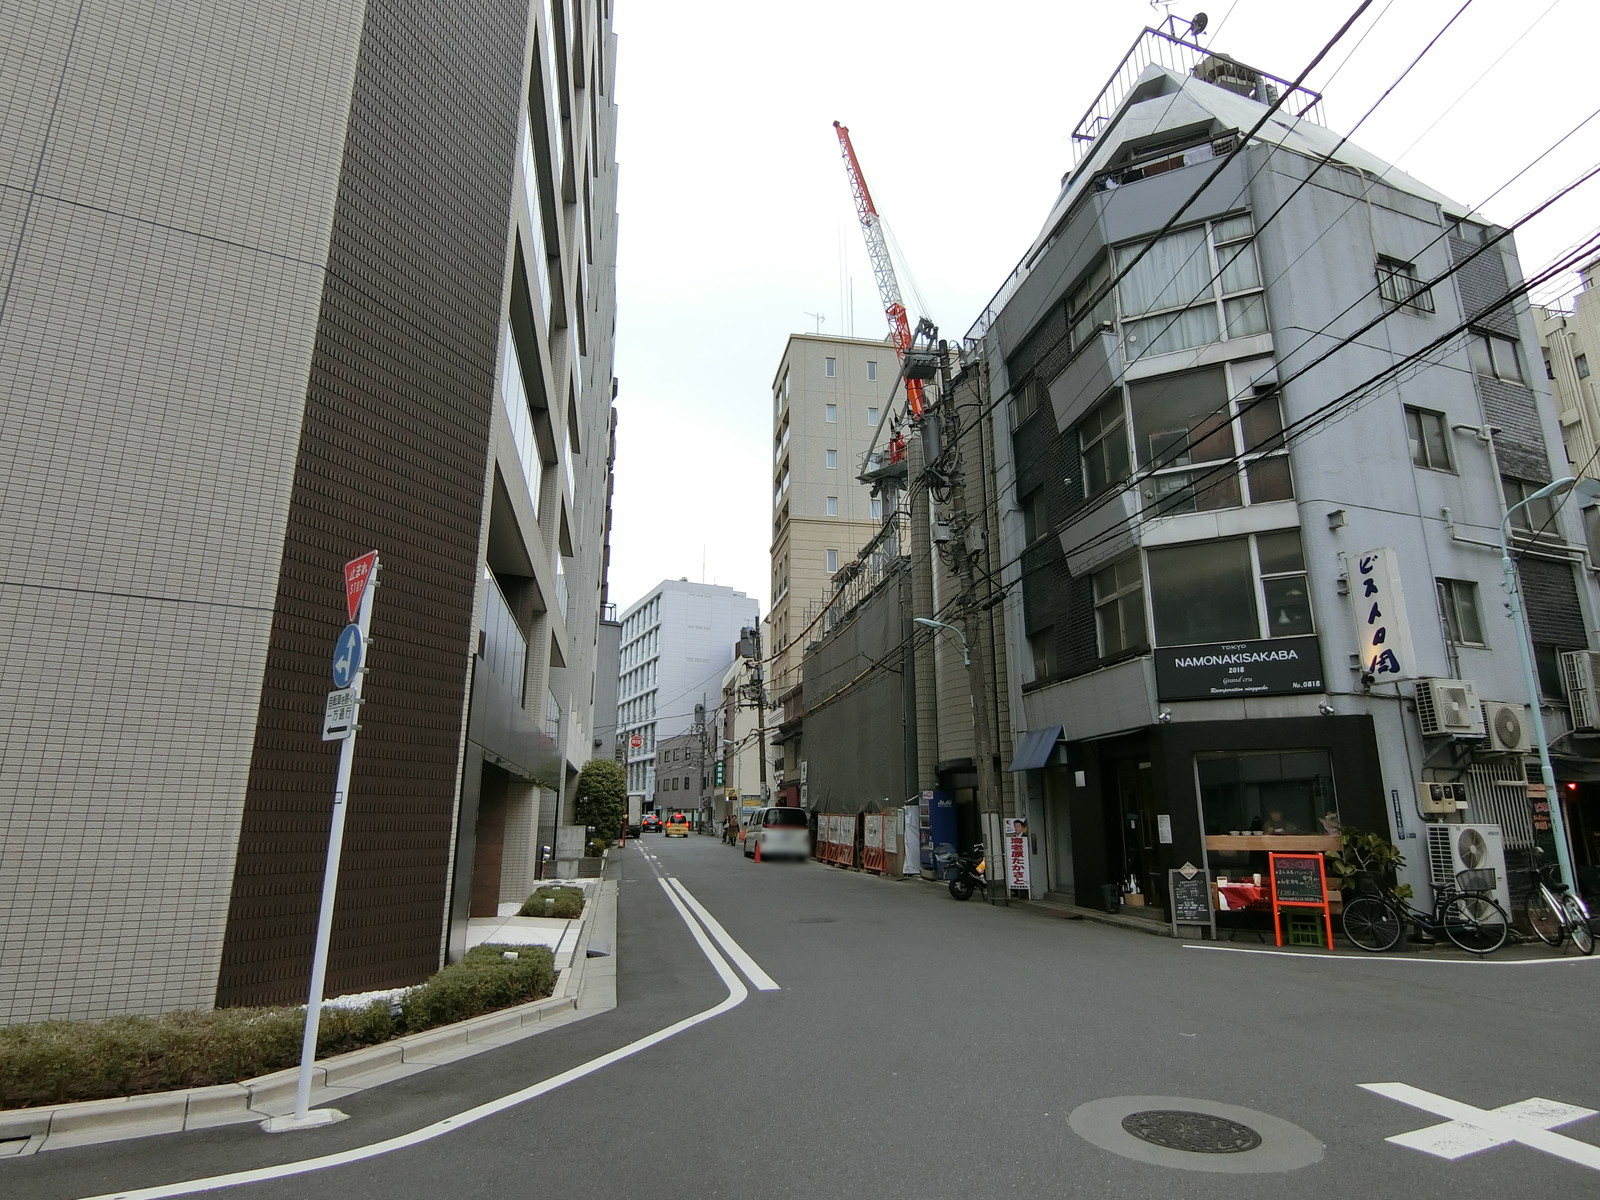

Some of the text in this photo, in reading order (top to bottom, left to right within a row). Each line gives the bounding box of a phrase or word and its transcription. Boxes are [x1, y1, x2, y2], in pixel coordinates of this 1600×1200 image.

[348, 561, 368, 582] 止まれ
[349, 579, 364, 595] STOP
[1221, 643, 1247, 651] TOKYO
[1175, 649, 1299, 668] NAMONAKISAKABA
[1228, 666, 1245, 674] 2018
[1222, 675, 1243, 685] Grand
[1292, 680, 1321, 689] No.0818
[327, 706, 352, 721] 一方通行
